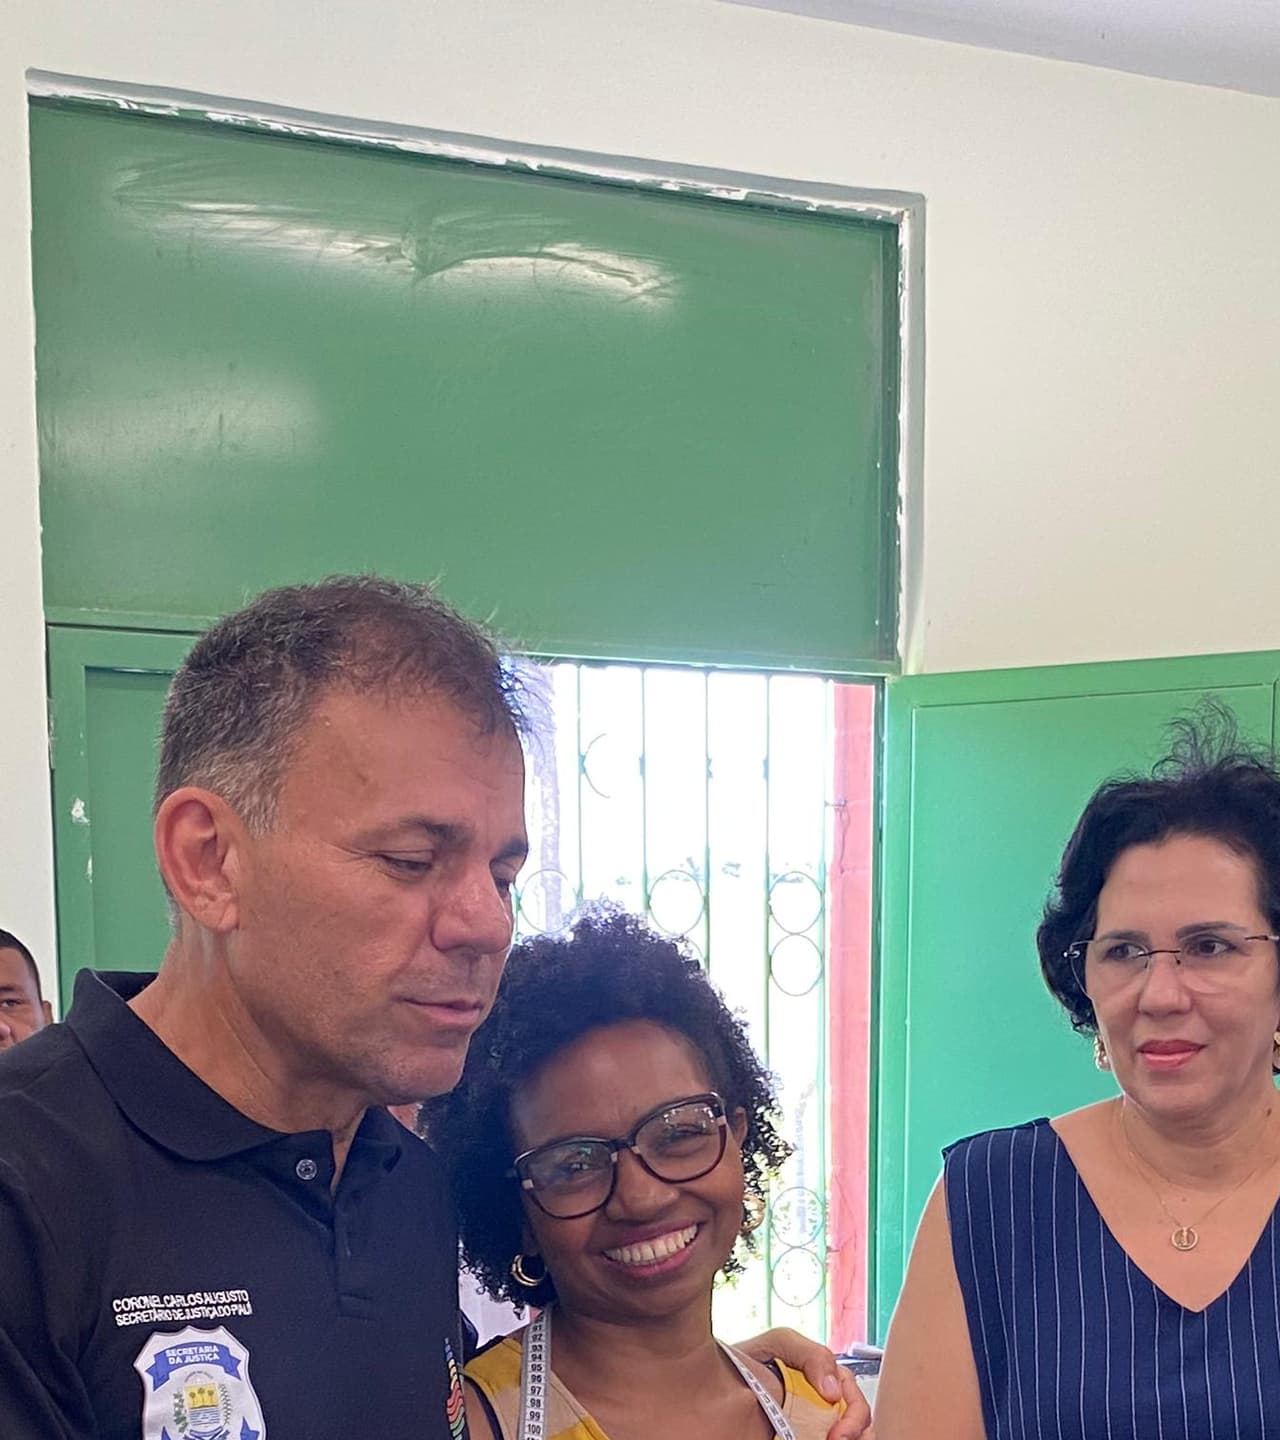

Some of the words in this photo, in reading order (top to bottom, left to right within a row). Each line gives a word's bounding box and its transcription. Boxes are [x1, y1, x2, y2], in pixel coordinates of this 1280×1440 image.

[112, 1295, 164, 1312] CORONEL
[163, 1292, 203, 1307] CARLOS
[204, 1290, 249, 1304] AUGUSTO
[173, 1308, 185, 1320] DE
[165, 1345, 220, 1357] SECRETARIA
[168, 1357, 183, 1365] DA
[531, 1353, 542, 1361] 94
[531, 1364, 542, 1372] 95
[531, 1374, 542, 1383] 96
[530, 1385, 541, 1395] 97
[530, 1398, 541, 1408] 98
[529, 1410, 540, 1421] 99
[527, 1423, 541, 1434] 100
